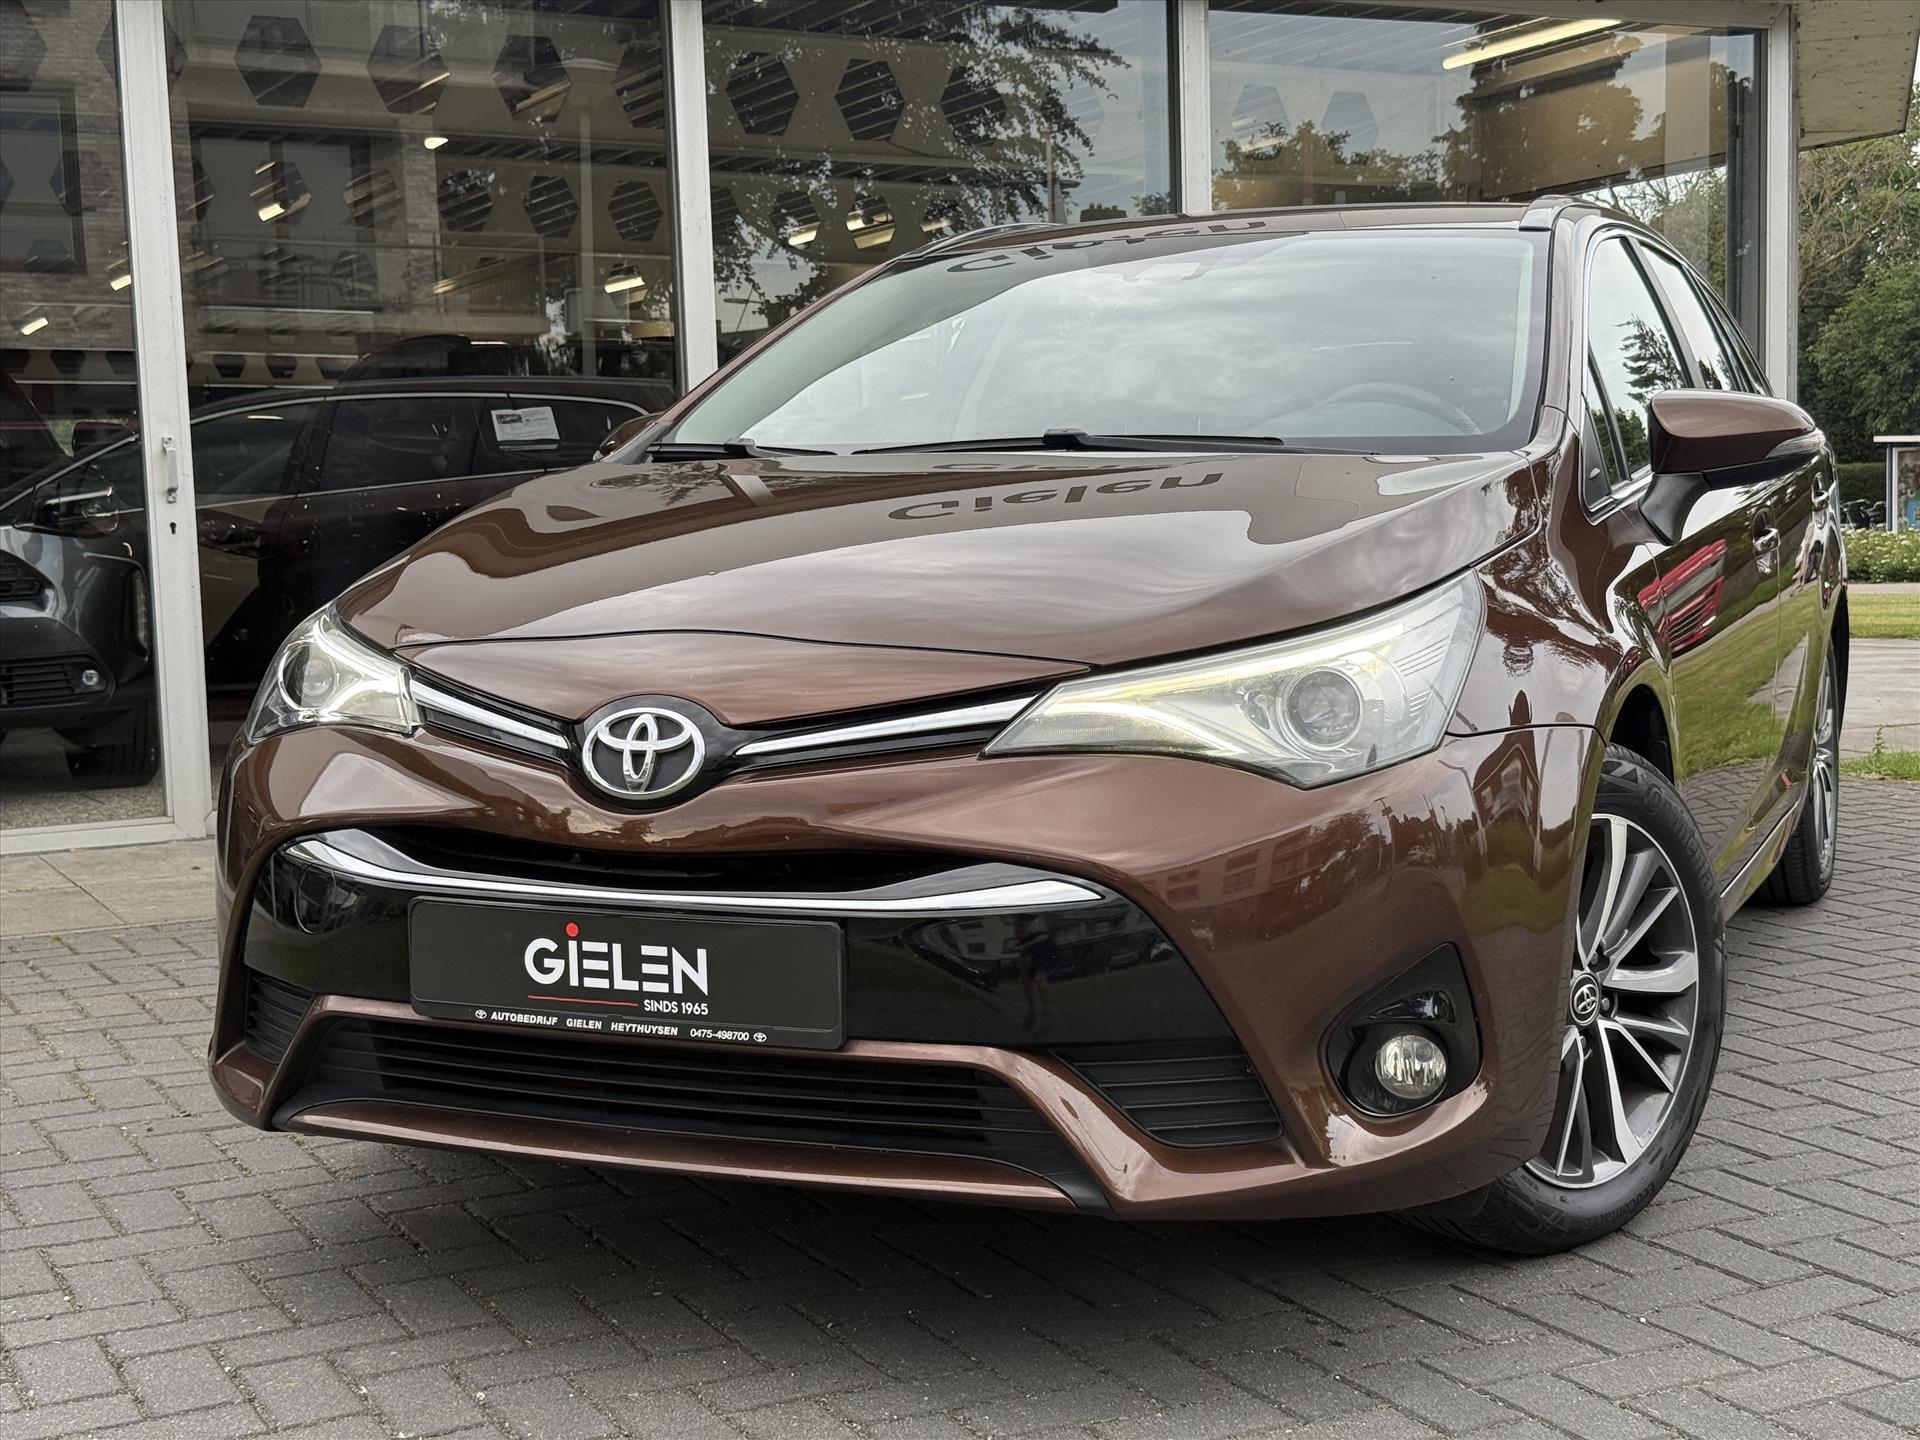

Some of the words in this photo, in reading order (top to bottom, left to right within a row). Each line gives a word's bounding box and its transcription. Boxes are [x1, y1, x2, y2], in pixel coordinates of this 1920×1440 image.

[643, 999, 679, 1014] SINDS
[681, 1001, 709, 1016] 1965
[490, 1011, 558, 1026] AUTOBEDRIJF
[566, 1018, 602, 1030] GIELEN
[610, 1021, 678, 1036] HEYTHUYSEN
[690, 1028, 750, 1041] 0475-498700
